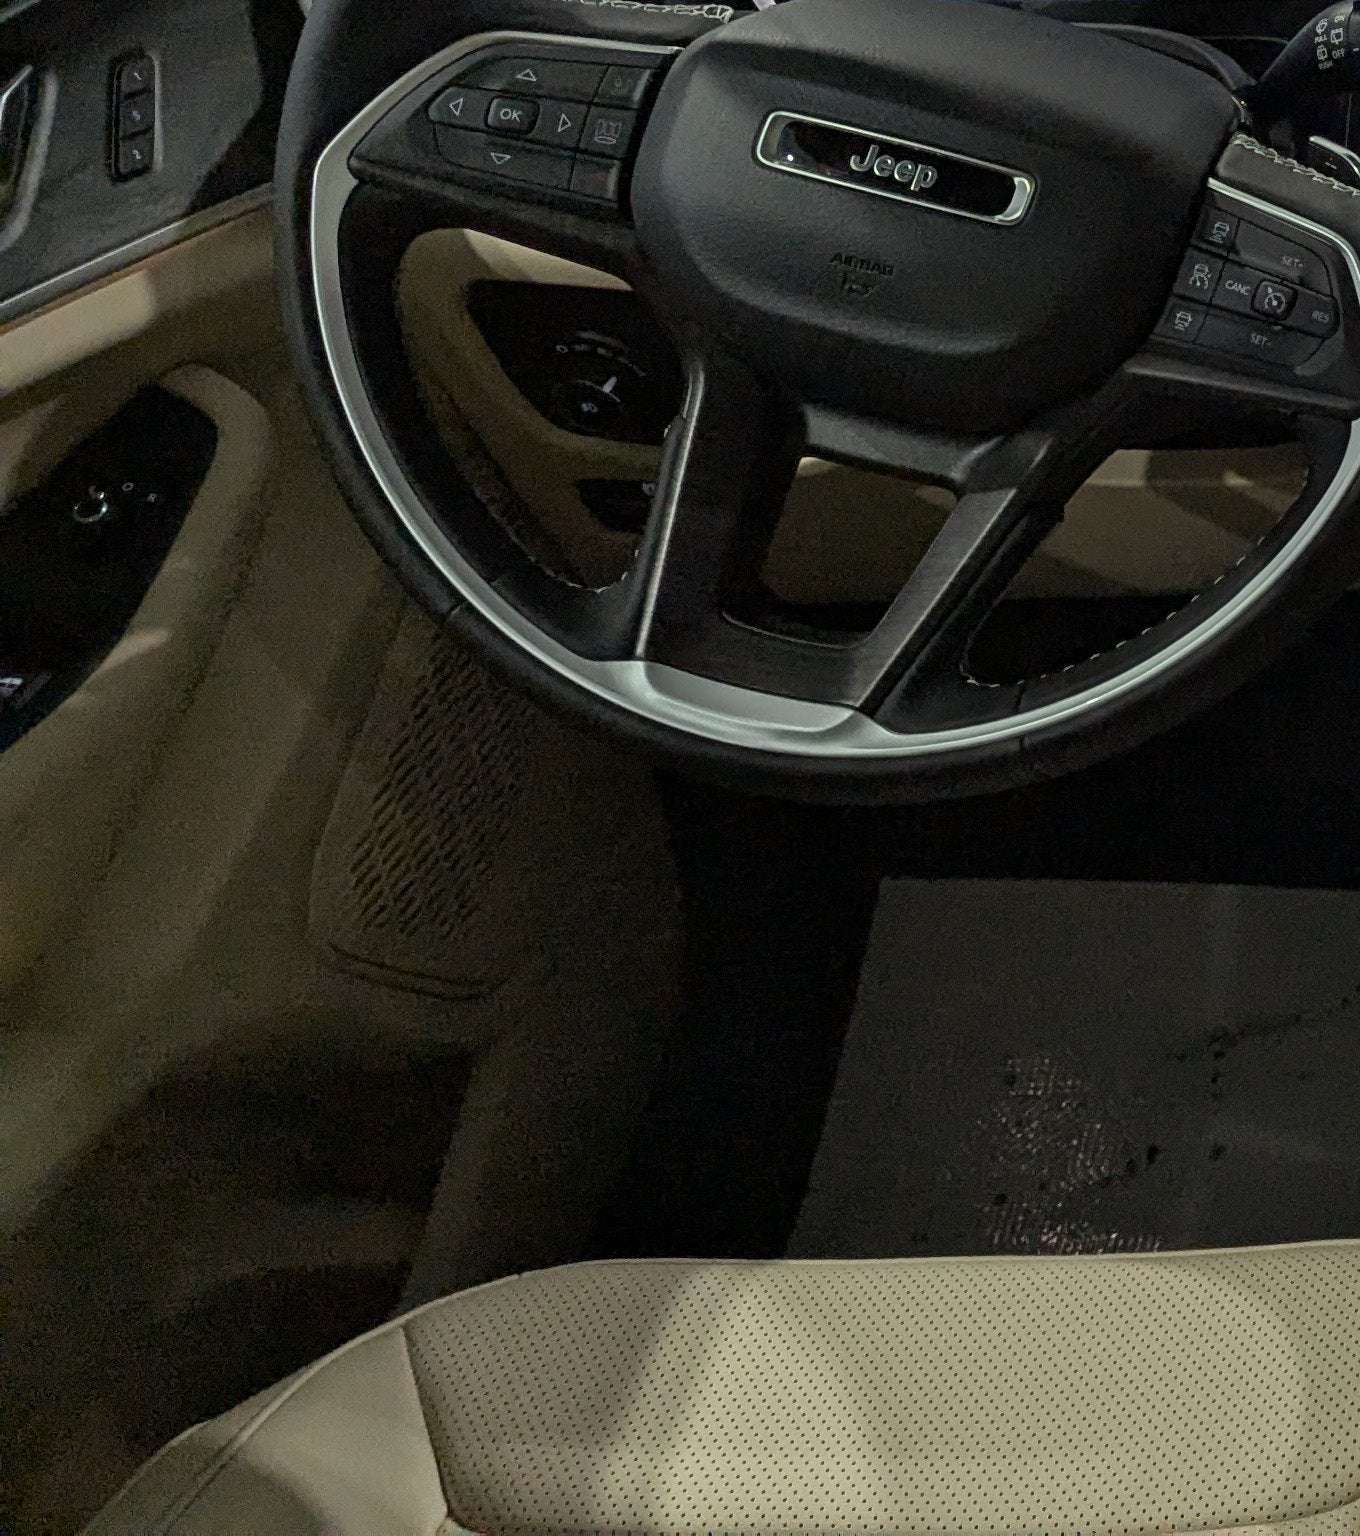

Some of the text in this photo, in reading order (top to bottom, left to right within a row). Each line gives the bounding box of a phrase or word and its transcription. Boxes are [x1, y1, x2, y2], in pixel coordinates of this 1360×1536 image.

[500, 108, 521, 122] OK
[850, 144, 938, 192] Jeep
[1225, 279, 1250, 296] CANC
[1312, 310, 1329, 324] RES
